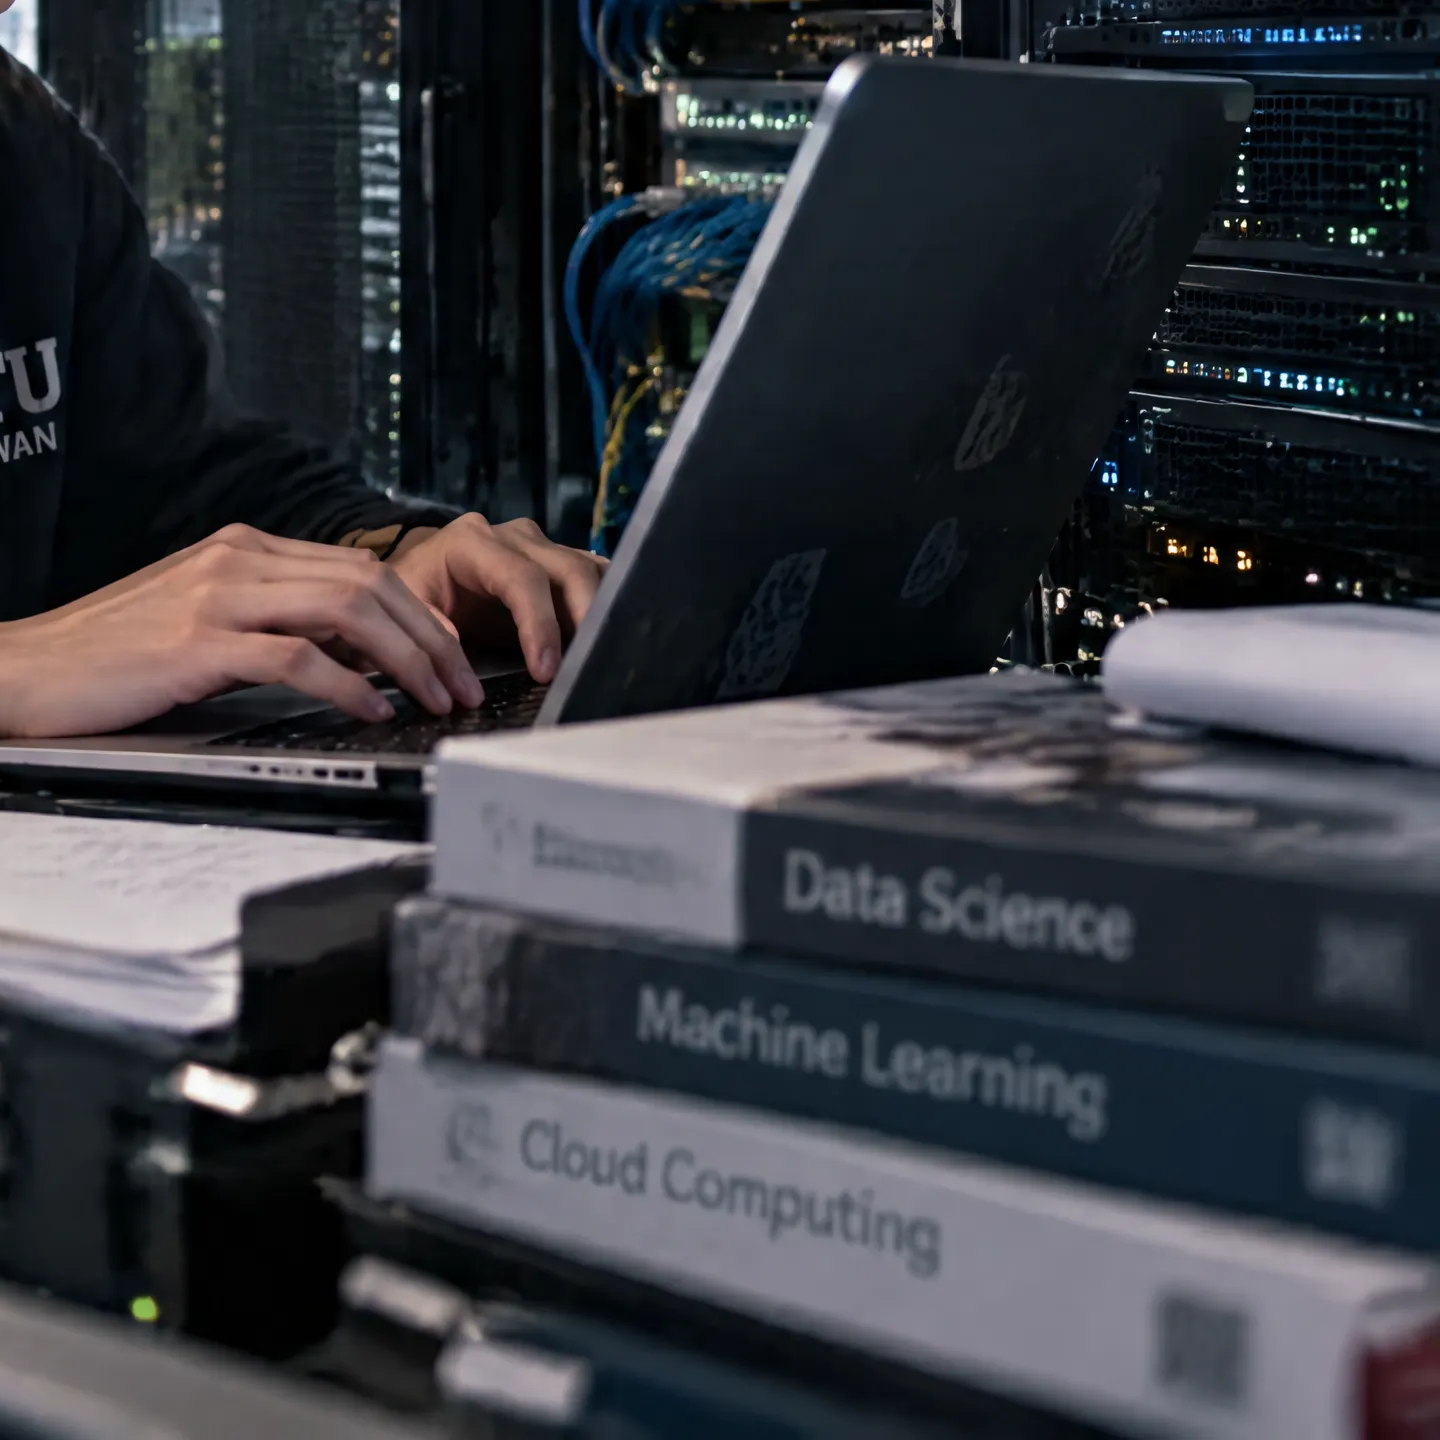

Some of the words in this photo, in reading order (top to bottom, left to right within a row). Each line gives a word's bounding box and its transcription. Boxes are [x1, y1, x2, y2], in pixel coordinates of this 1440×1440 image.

[783, 849, 908, 928] Data
[921, 869, 1135, 961] Science
[637, 985, 850, 1078] Machine
[863, 1024, 1106, 1139] Learning
[520, 1118, 648, 1195] Cloud
[661, 1148, 941, 1279] Computing
